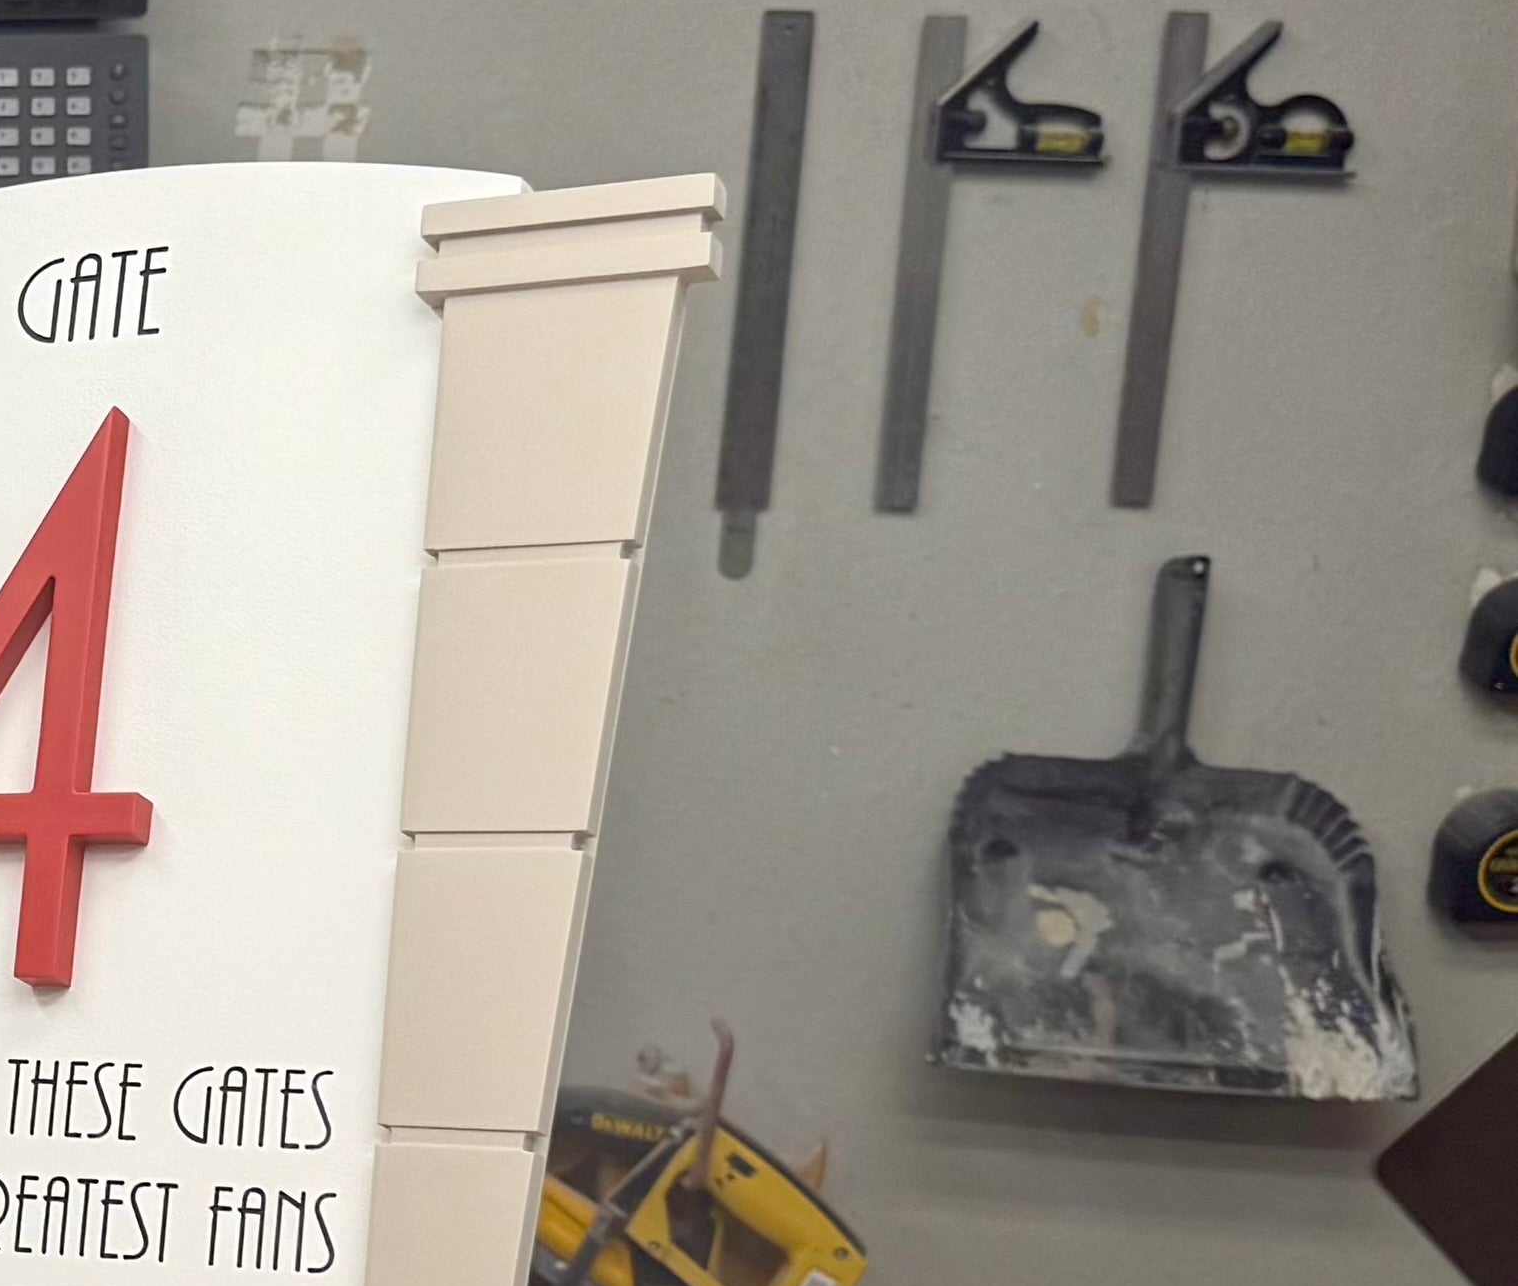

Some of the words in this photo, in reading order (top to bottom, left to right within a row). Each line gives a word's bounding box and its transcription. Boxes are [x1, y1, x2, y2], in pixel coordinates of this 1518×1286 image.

[18, 246, 169, 343] GATE
[8, 1059, 143, 1141] THESE
[173, 1066, 334, 1150] GATES
[208, 1186, 337, 1273] FANS
